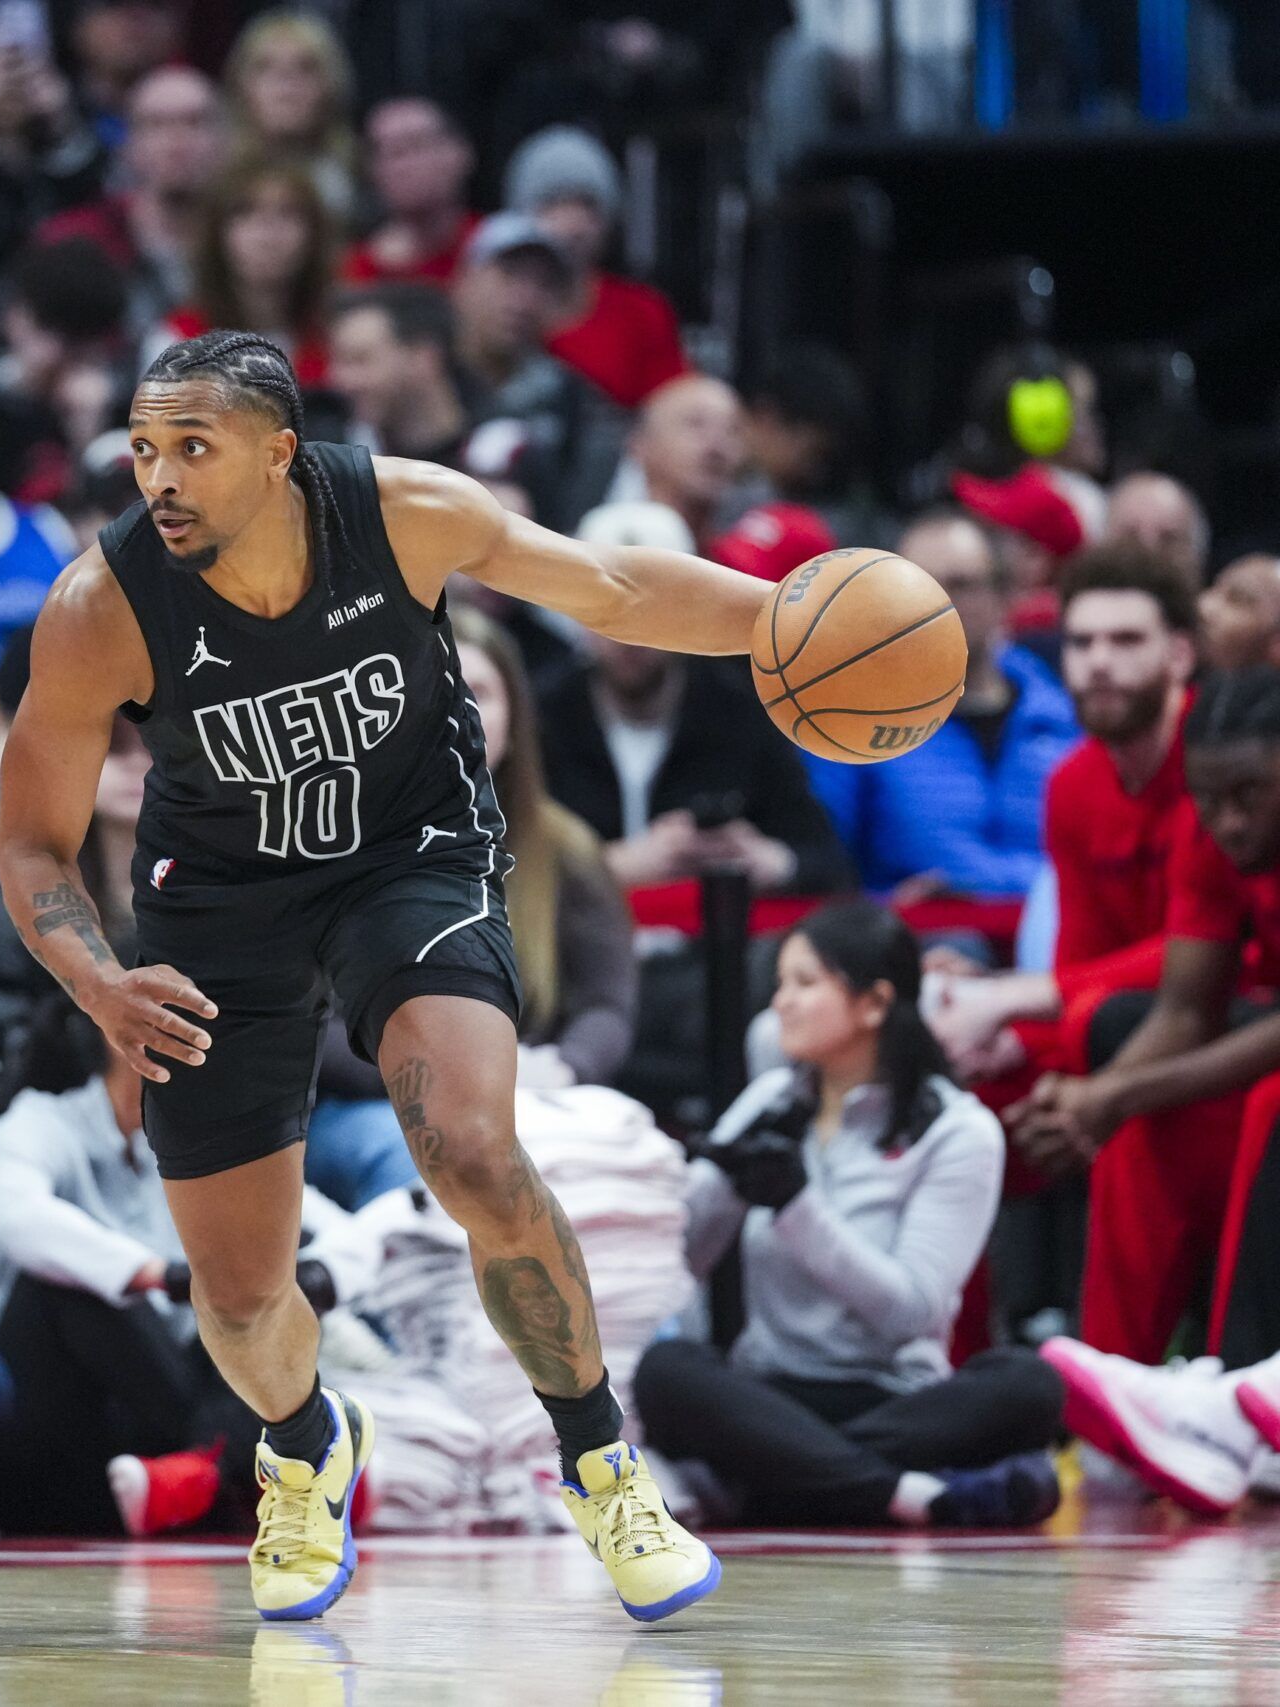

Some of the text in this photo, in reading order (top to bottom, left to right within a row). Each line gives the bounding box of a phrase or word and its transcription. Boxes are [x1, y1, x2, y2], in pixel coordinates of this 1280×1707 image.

[327, 592, 385, 630] All In Won
[193, 653, 405, 784] NETS
[250, 765, 361, 859] 10
